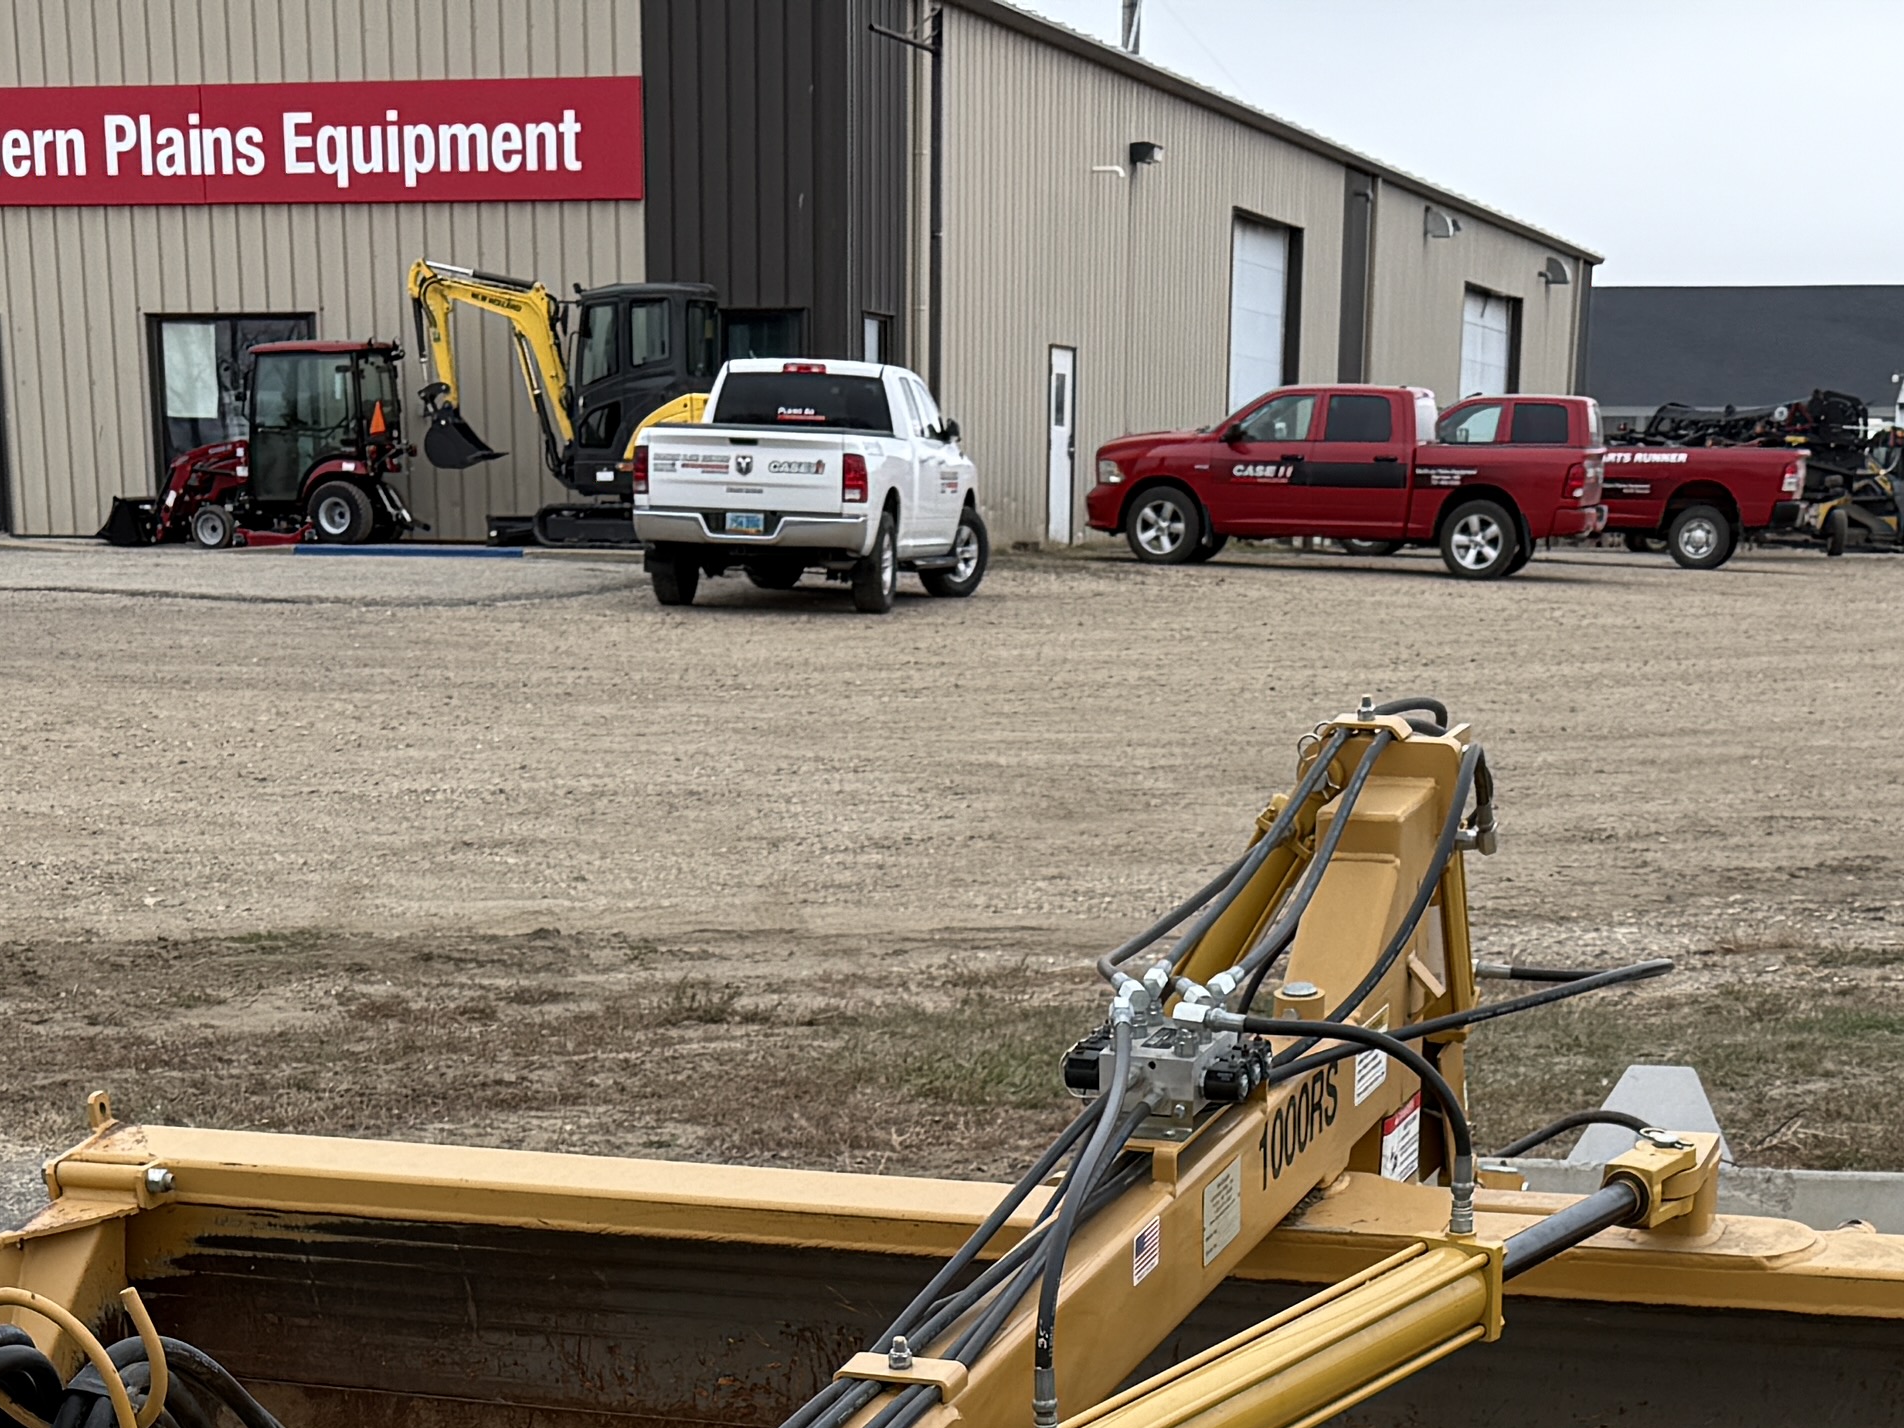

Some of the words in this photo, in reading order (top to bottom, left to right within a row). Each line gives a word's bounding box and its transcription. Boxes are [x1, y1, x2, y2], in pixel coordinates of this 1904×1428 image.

[104, 113, 266, 176] Plains
[283, 109, 582, 188] Equipment
[1232, 464, 1277, 477] CASE
[1259, 1060, 1339, 1191] 1000RS
